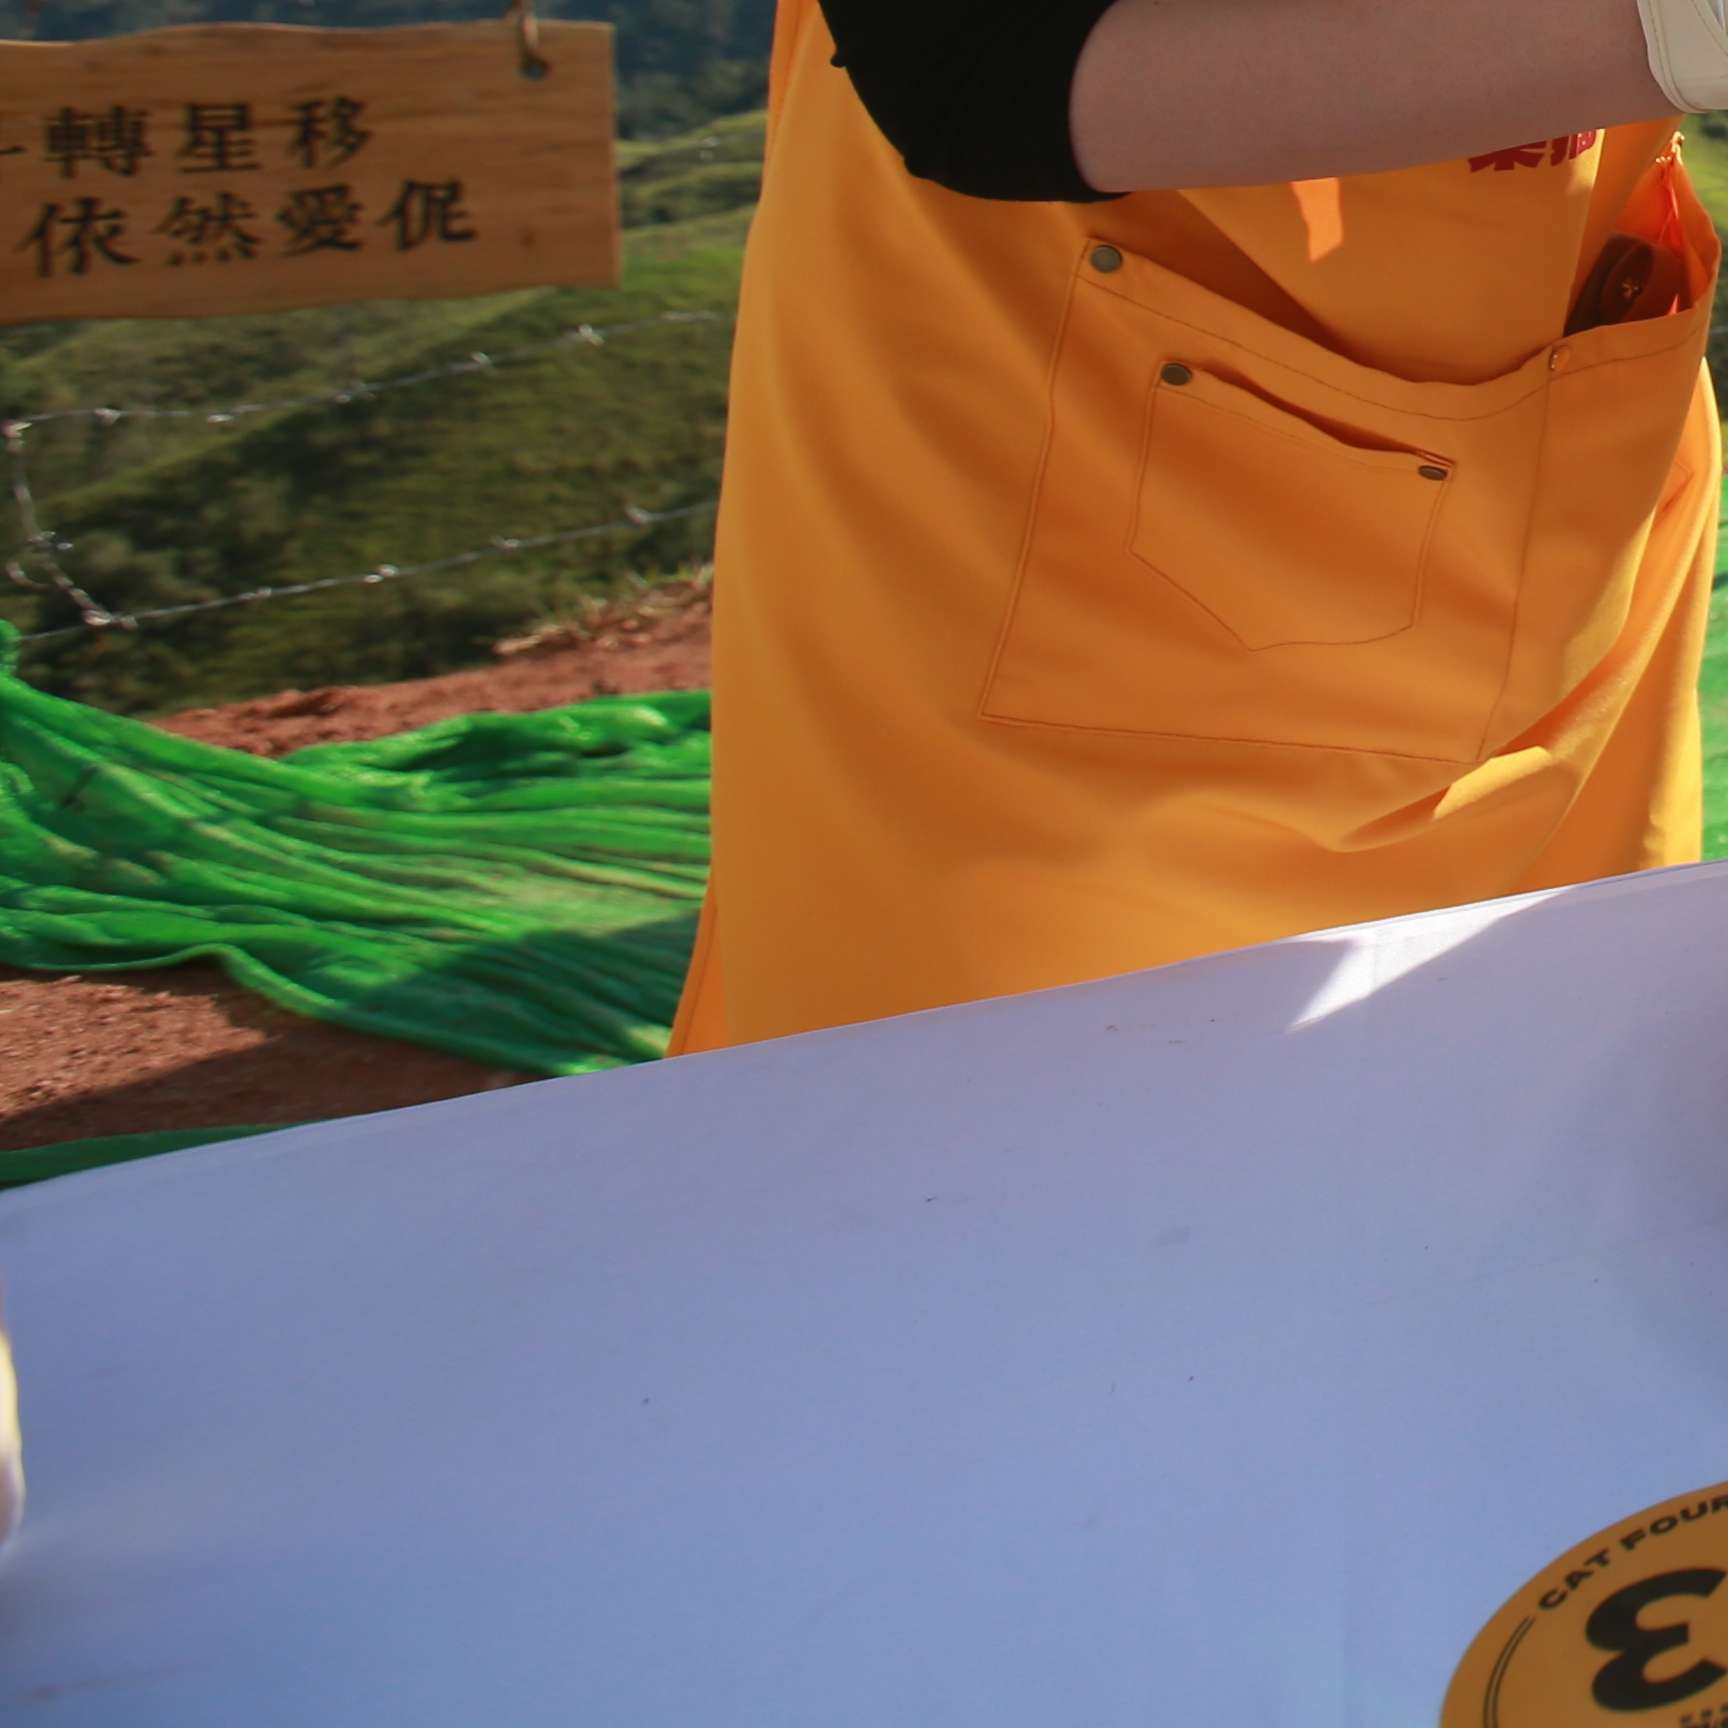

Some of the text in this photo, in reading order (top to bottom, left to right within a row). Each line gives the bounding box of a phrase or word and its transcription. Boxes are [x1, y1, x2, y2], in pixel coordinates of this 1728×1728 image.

[0, 95, 372, 178] 轉星移
[1537, 1547, 1611, 1610] CAT
